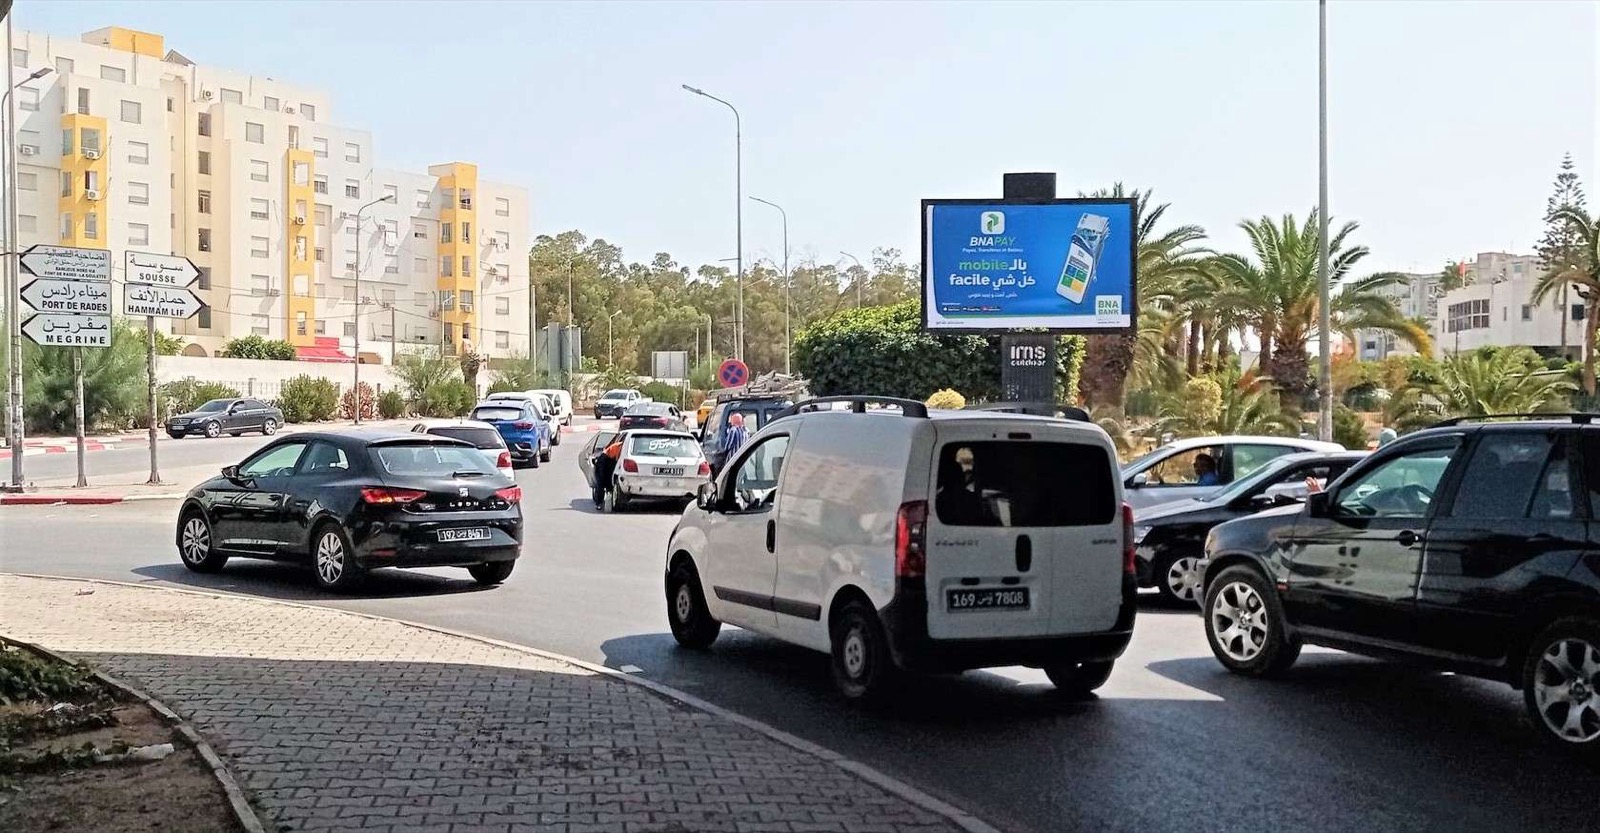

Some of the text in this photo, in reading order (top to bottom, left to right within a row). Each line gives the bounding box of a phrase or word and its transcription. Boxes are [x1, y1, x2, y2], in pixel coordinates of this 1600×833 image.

[969, 236, 1016, 247] BNAPAY
[129, 253, 184, 273] سوسة
[959, 259, 1008, 271] mobile
[139, 272, 176, 284] SOUSSE
[949, 273, 1036, 291] كل شي facile
[42, 283, 107, 301] ميناء رادس
[129, 287, 187, 309] حمام الأنف
[42, 300, 108, 312] PORT DE RADES
[128, 304, 185, 317] HAMMAM LIF
[1098, 300, 1119, 309] BNA
[46, 334, 106, 345] MEGRINE
[648, 438, 682, 451] Ford
[952, 593, 976, 607] 169
[995, 591, 1024, 605] 7808
